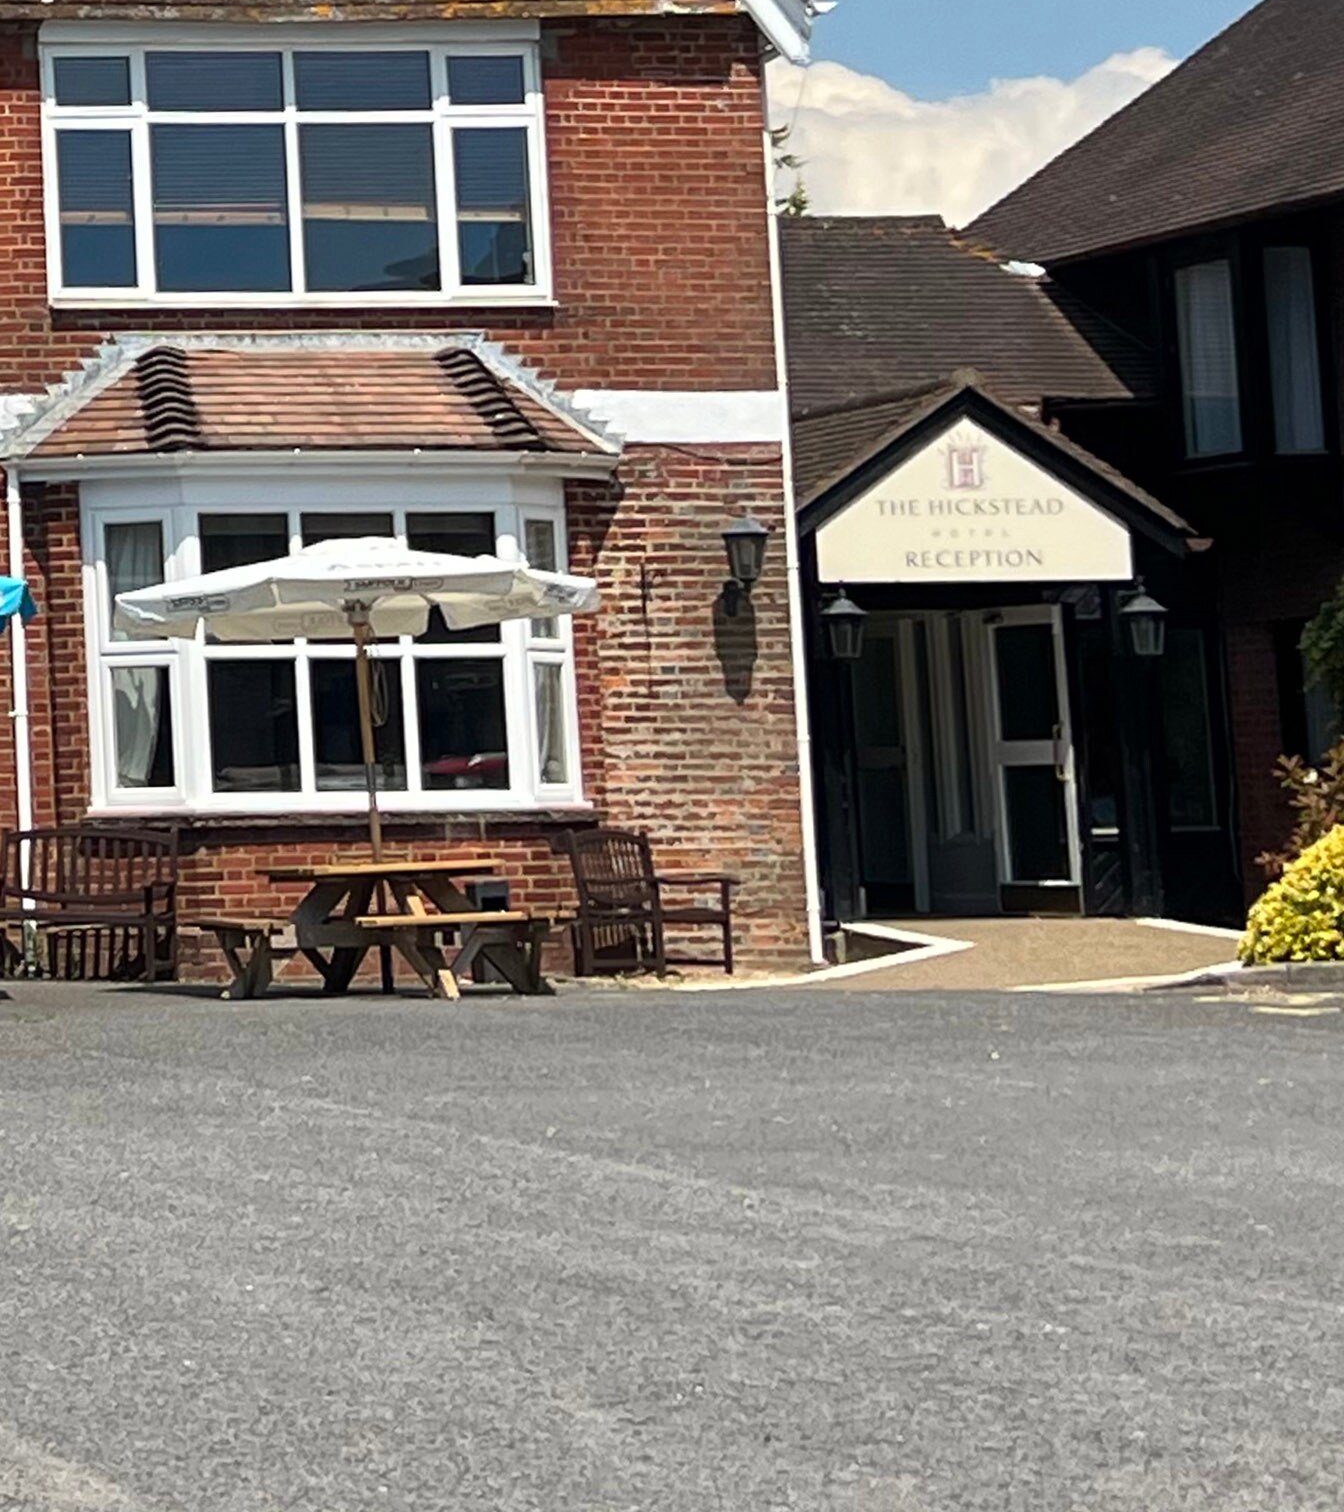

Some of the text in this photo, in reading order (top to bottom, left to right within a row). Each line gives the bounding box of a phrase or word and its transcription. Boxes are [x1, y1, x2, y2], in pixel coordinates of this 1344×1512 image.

[875, 497, 1065, 517] THE HICKSTEAD
[931, 528, 1011, 538] HOTEL
[905, 549, 1045, 569] RECEPTION
